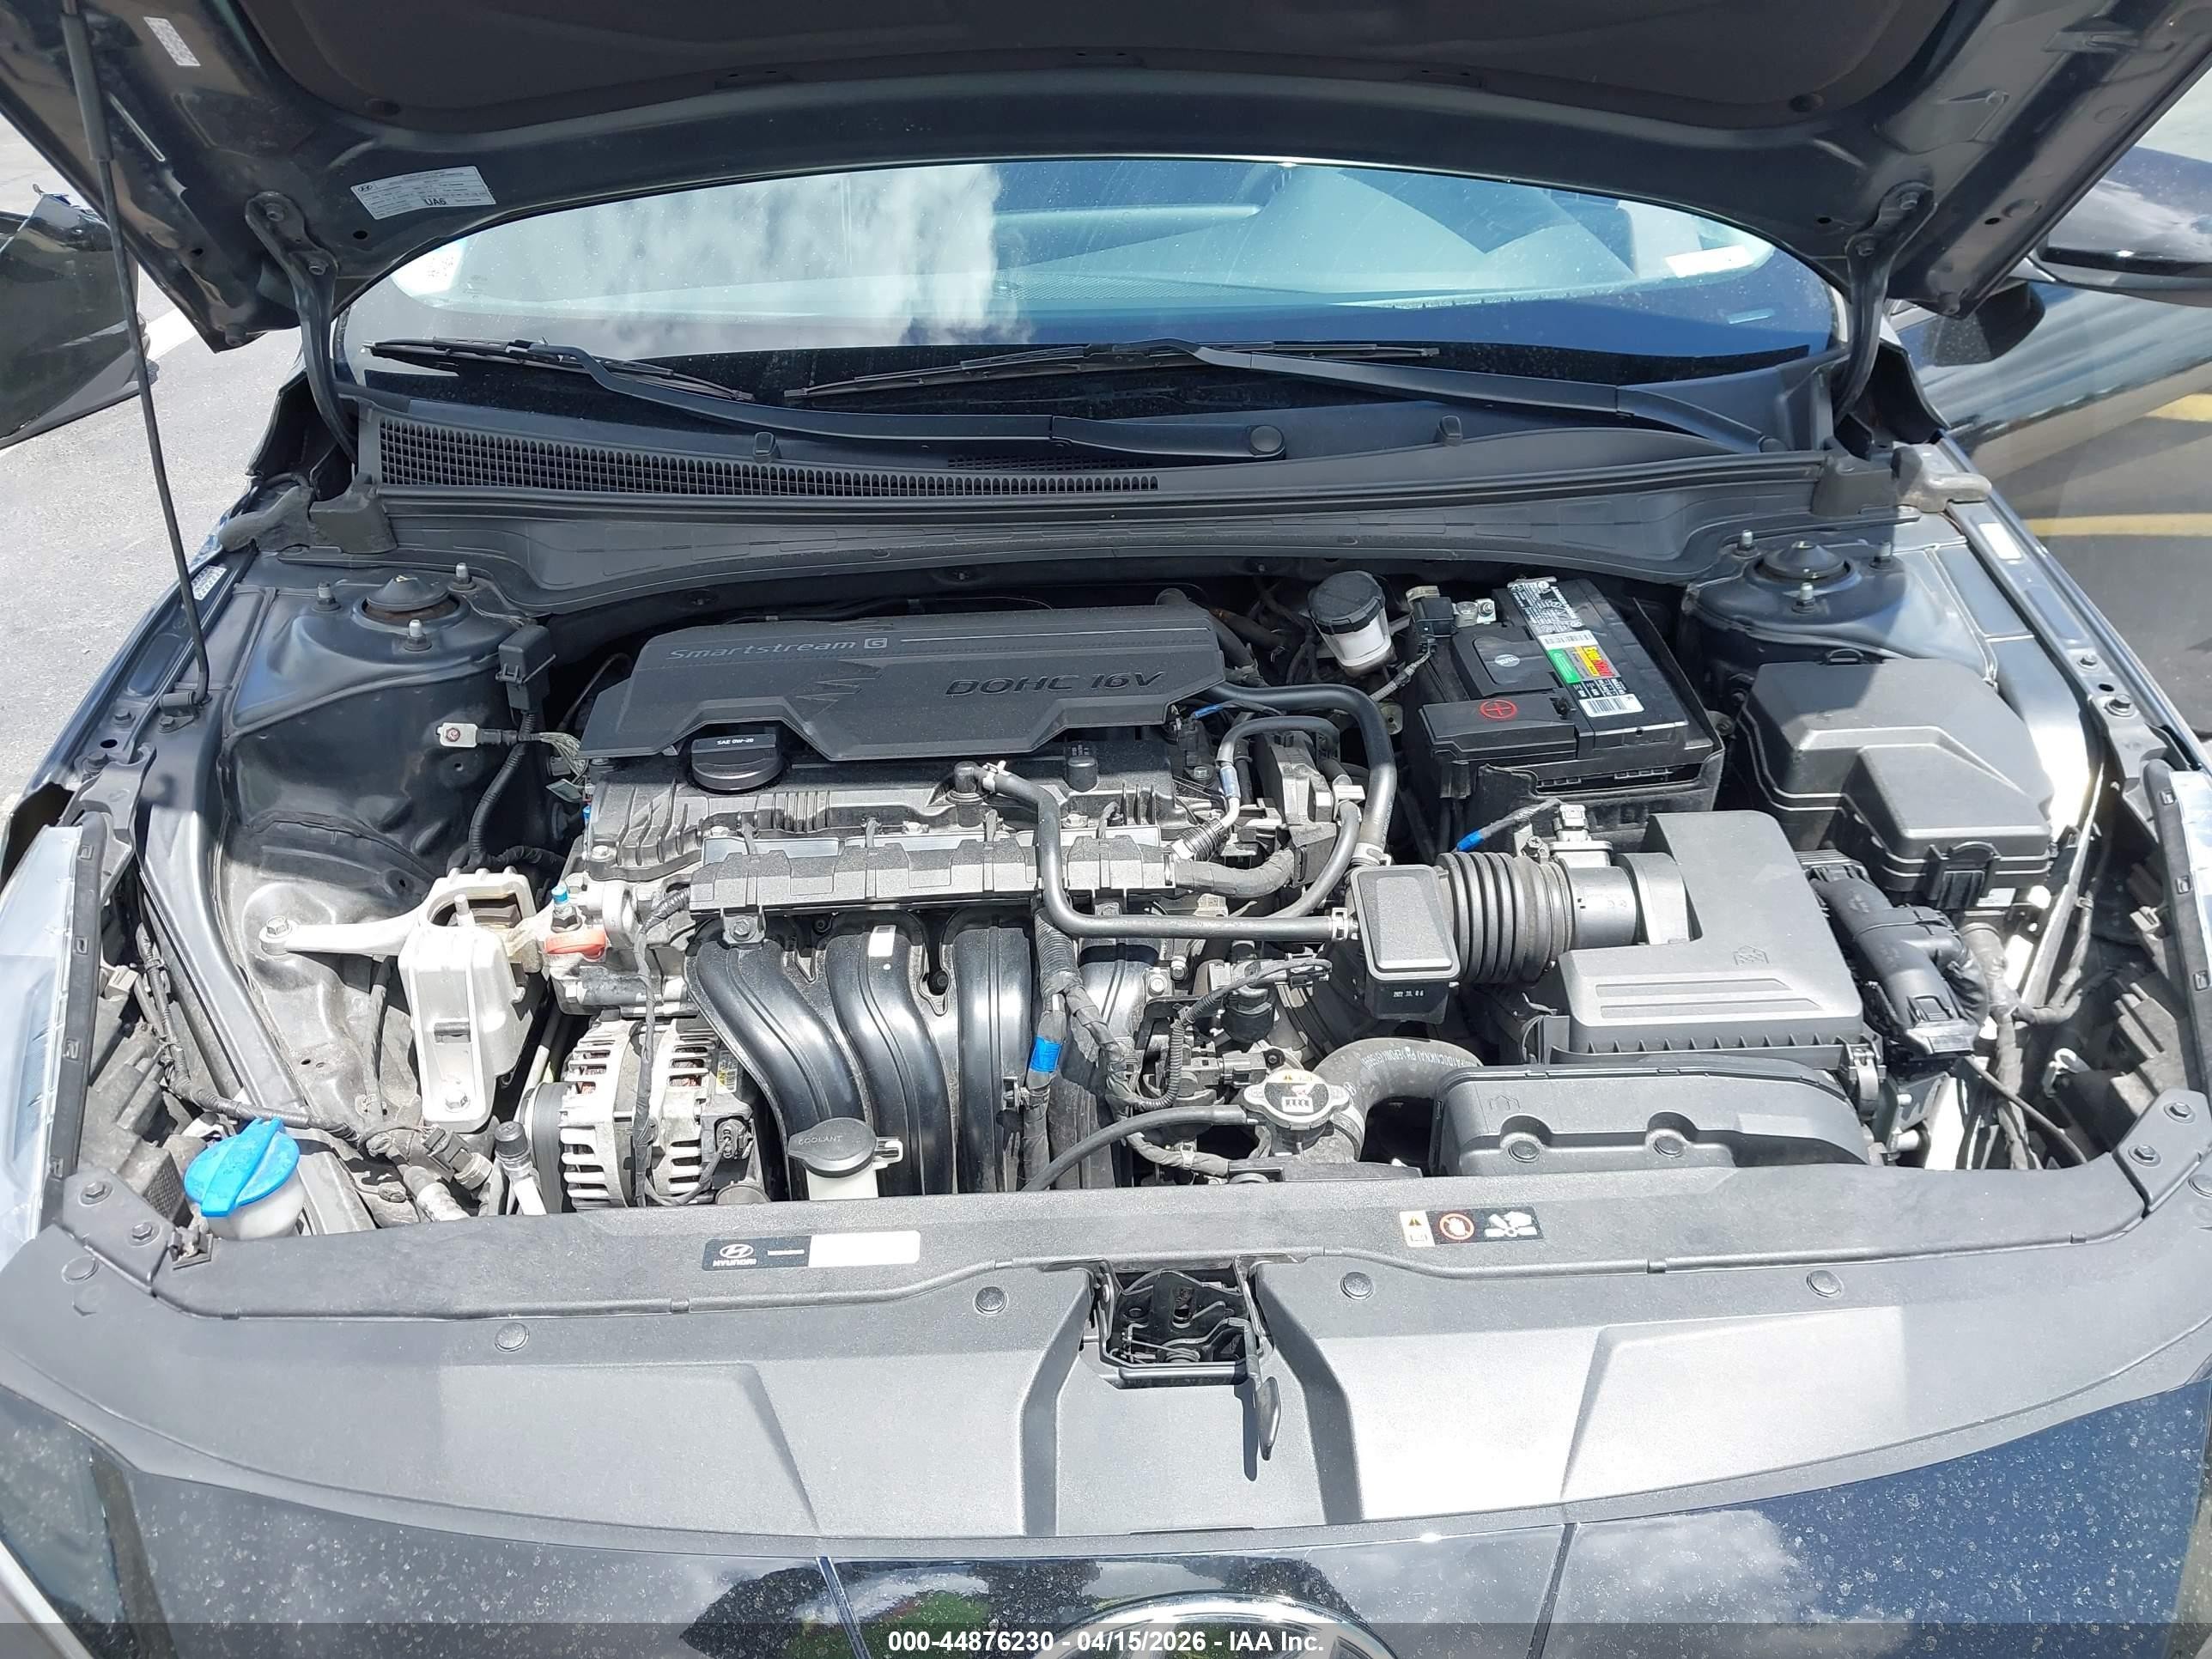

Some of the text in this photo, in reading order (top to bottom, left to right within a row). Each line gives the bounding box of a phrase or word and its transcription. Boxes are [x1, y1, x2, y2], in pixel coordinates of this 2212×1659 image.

[666, 641, 856, 659] Smartstream
[945, 671, 1167, 696] DOHC 16V
[798, 1134, 843, 1146] COOLANT
[712, 1258, 757, 1267] HYUNDAI
